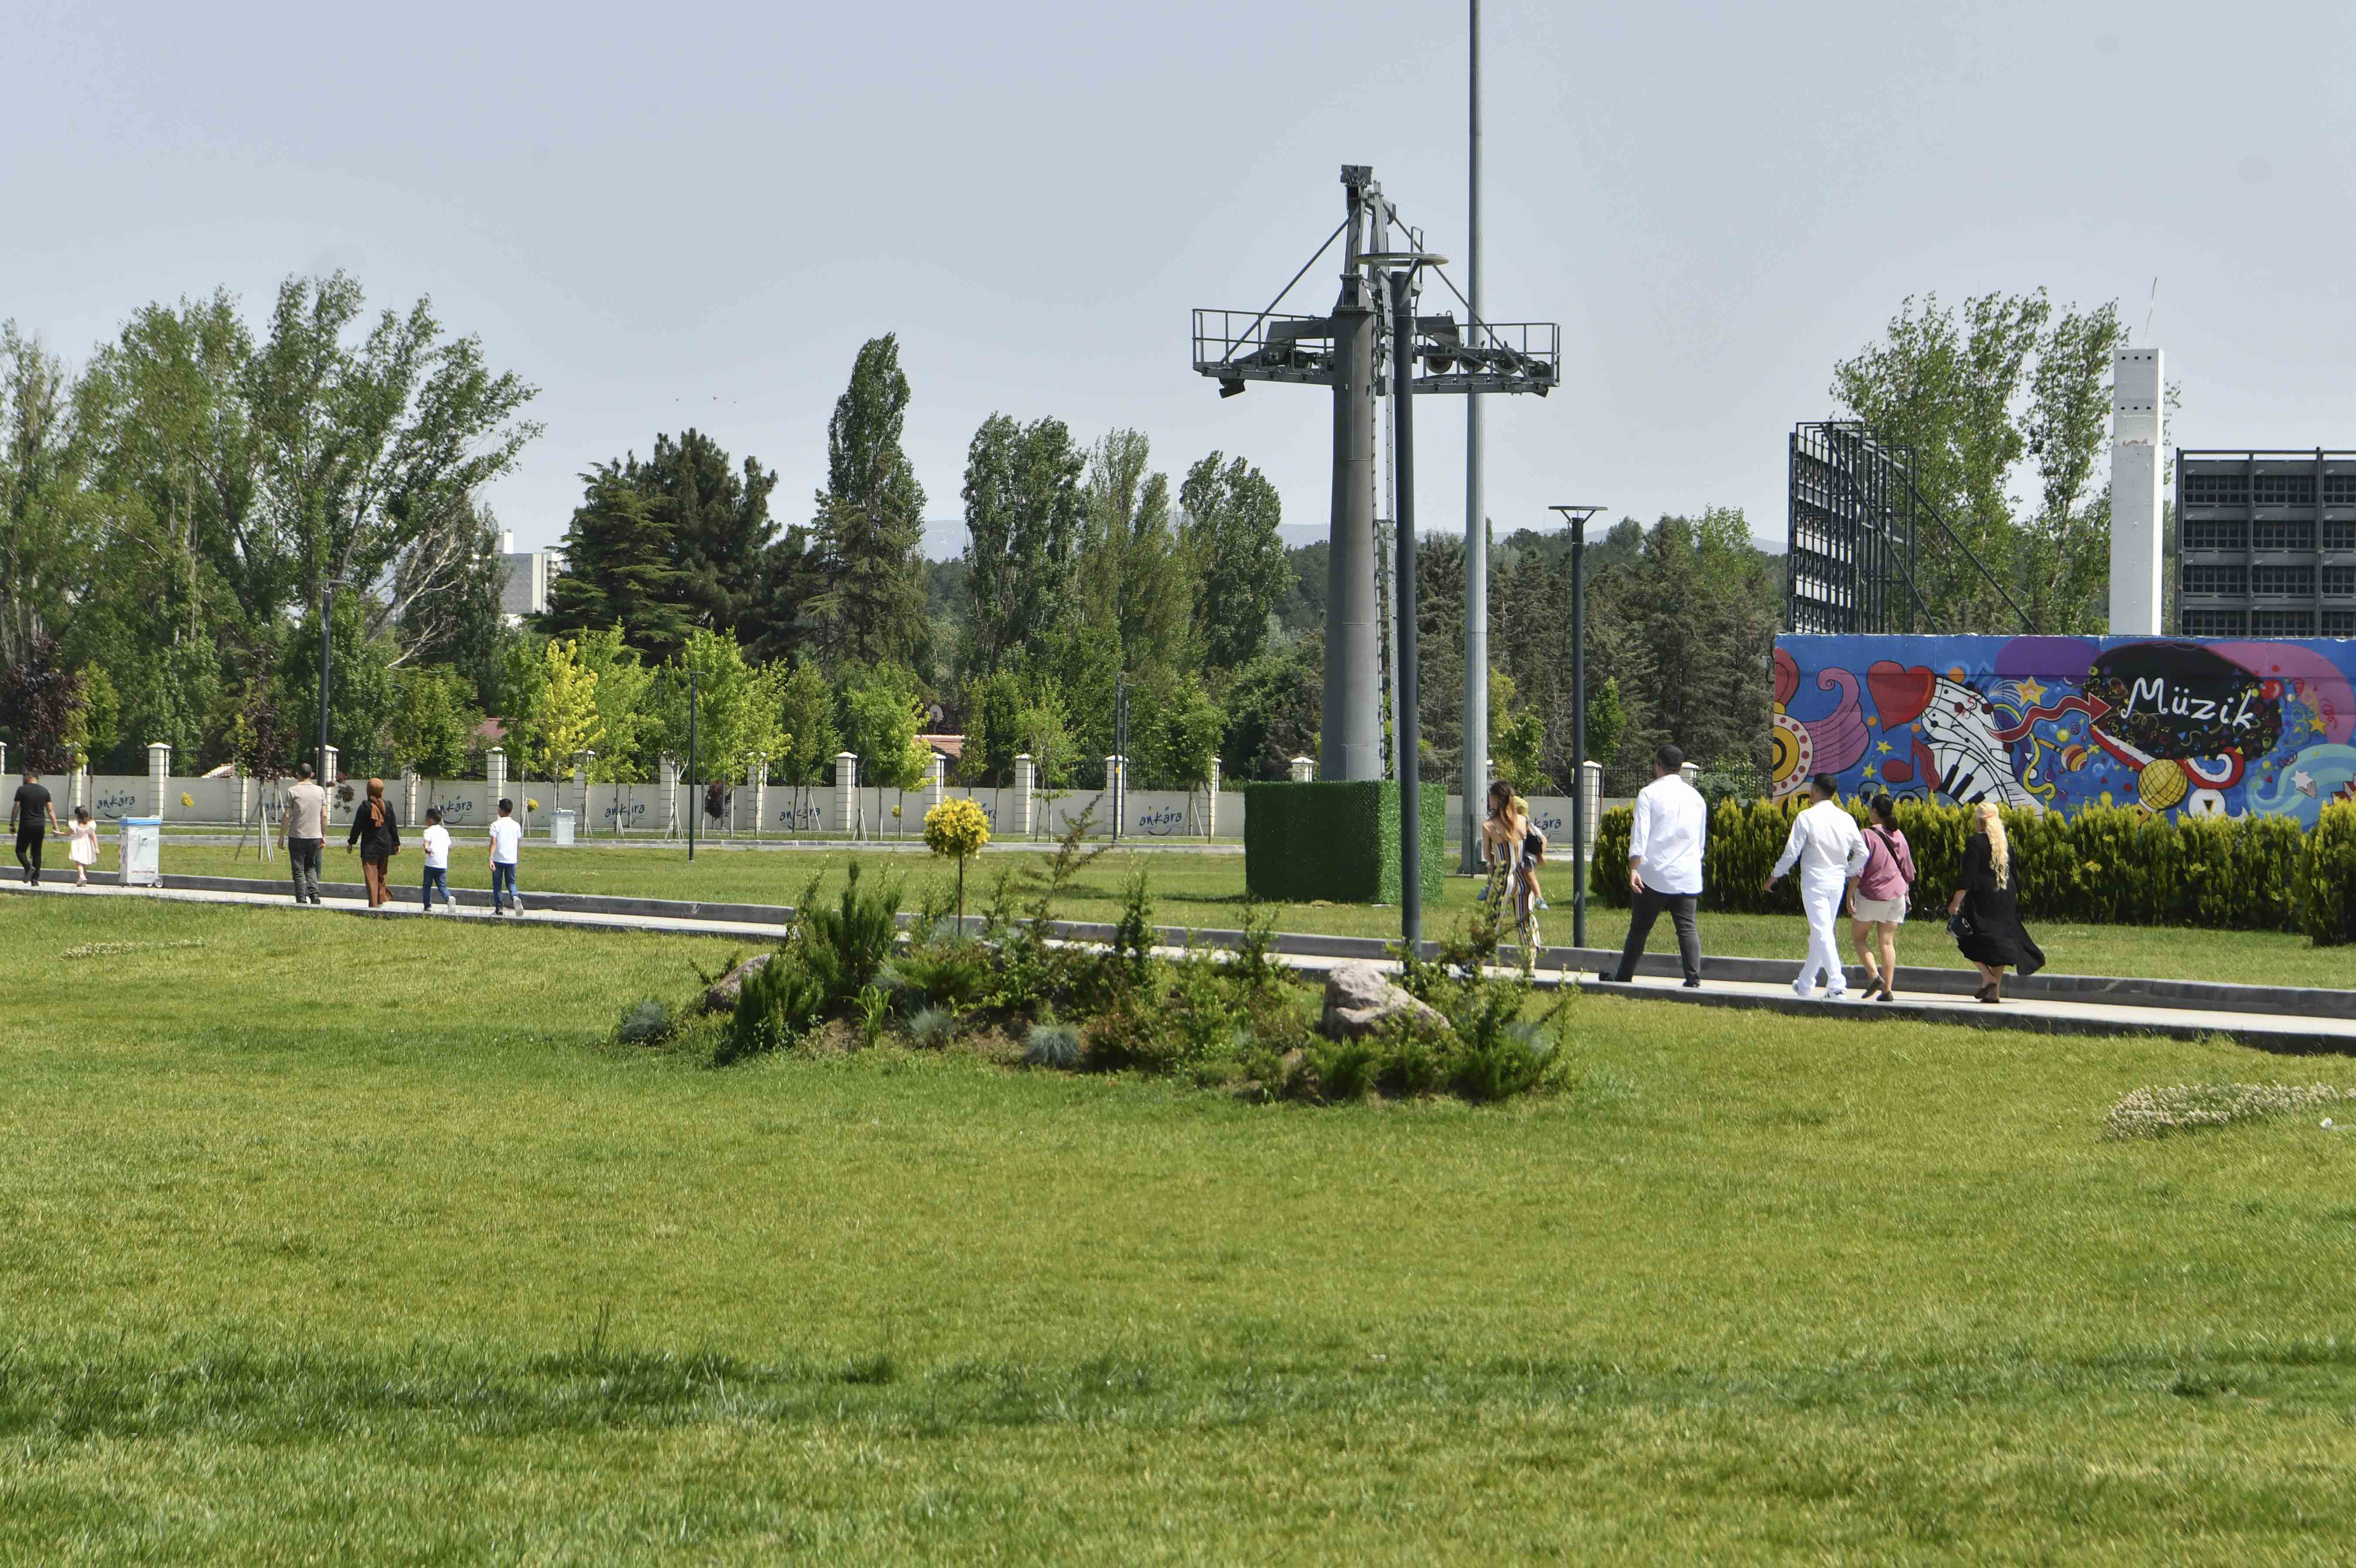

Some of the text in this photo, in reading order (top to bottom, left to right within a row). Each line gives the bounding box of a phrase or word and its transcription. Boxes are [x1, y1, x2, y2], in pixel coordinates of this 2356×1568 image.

[2120, 677, 2255, 729] Müzik
[97, 795, 135, 809] ankara
[1139, 811, 1182, 826] ankara
